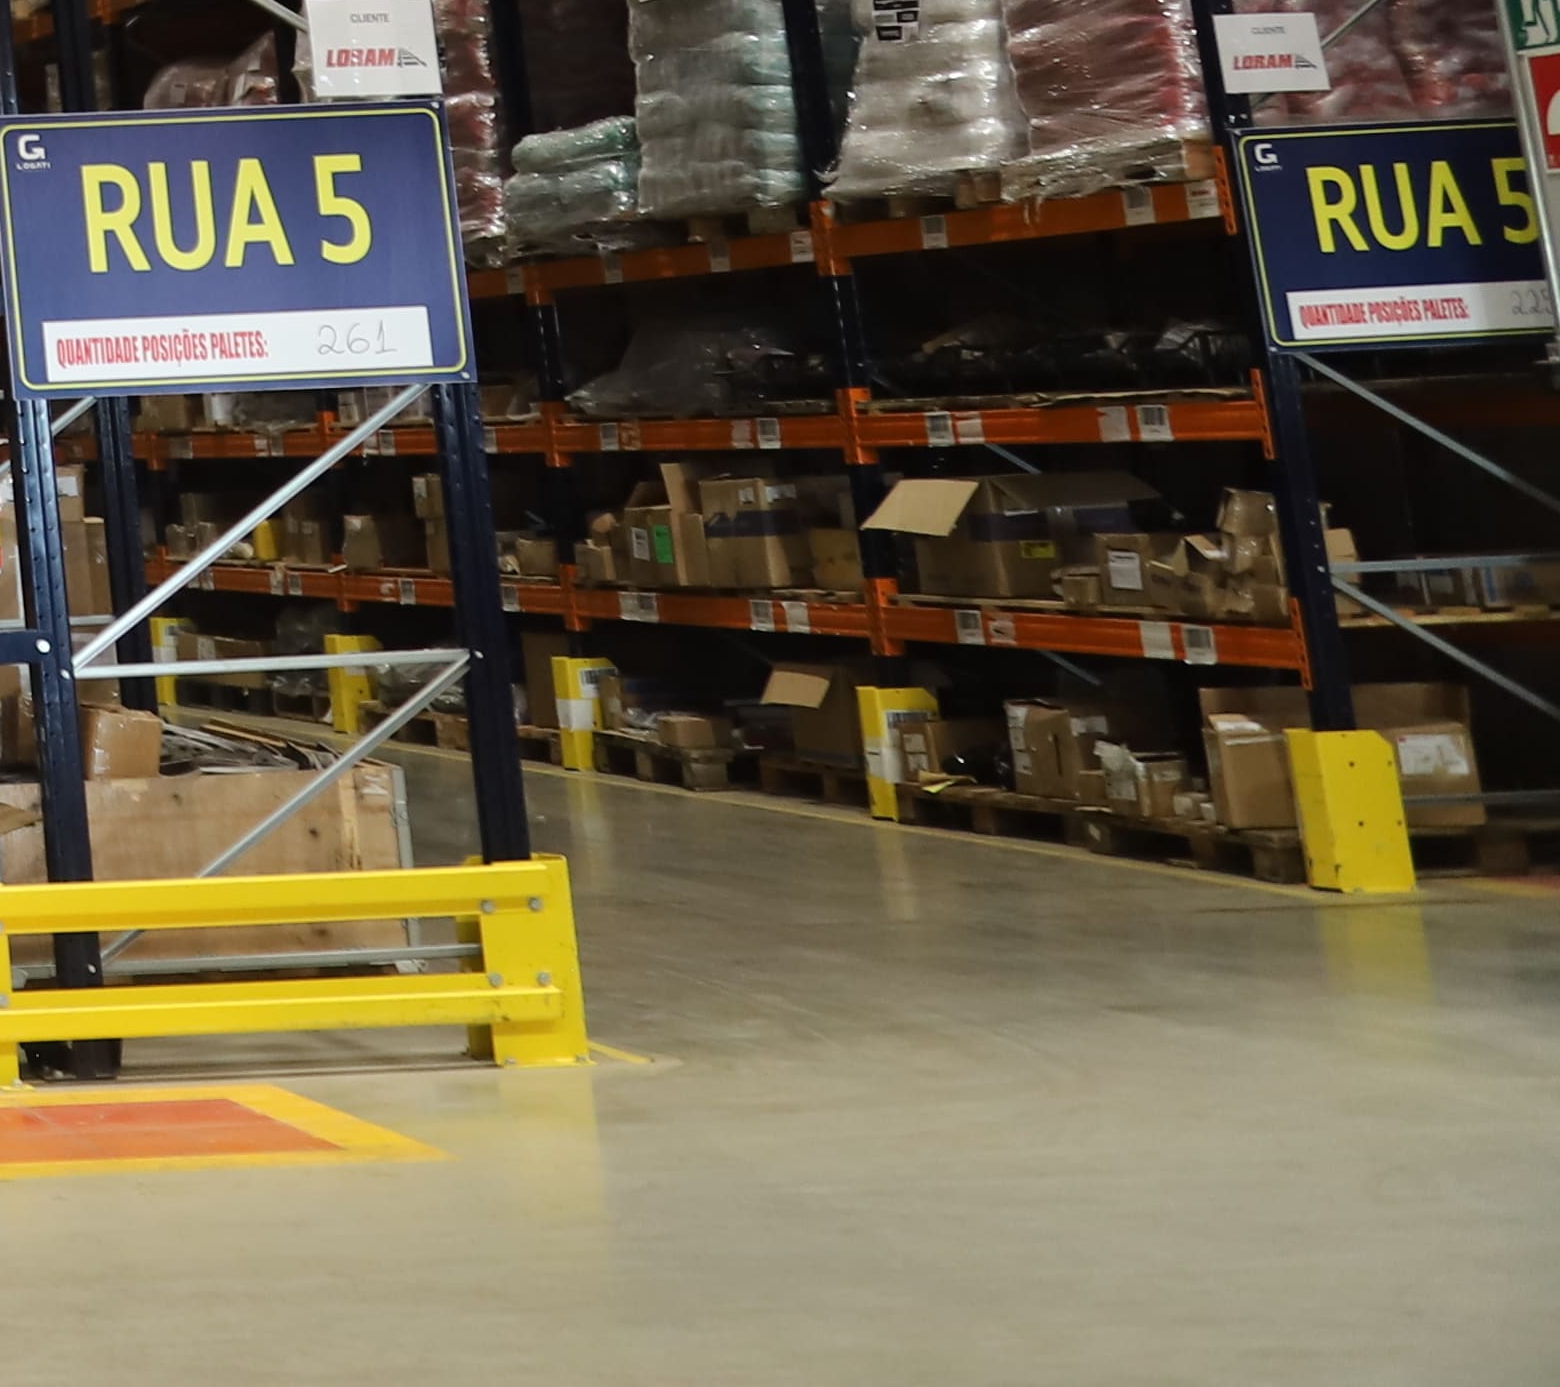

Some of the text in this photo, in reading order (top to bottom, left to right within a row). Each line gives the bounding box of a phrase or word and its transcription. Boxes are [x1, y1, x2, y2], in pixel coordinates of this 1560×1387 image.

[350, 12, 389, 24] CLIENTE
[1251, 26, 1285, 35] CLIENTE
[327, 48, 395, 69] LORAM
[1233, 54, 1293, 71] LORAM
[19, 134, 45, 160] G
[81, 154, 372, 273] RUA 5
[1305, 156, 1540, 253] RUA 5
[1300, 296, 1469, 329] QUANTIDADE POSIÇÕES PALETES:
[56, 328, 269, 368] QUANTIDADE POSIÇÕES PALETES:
[317, 320, 397, 355] 261
